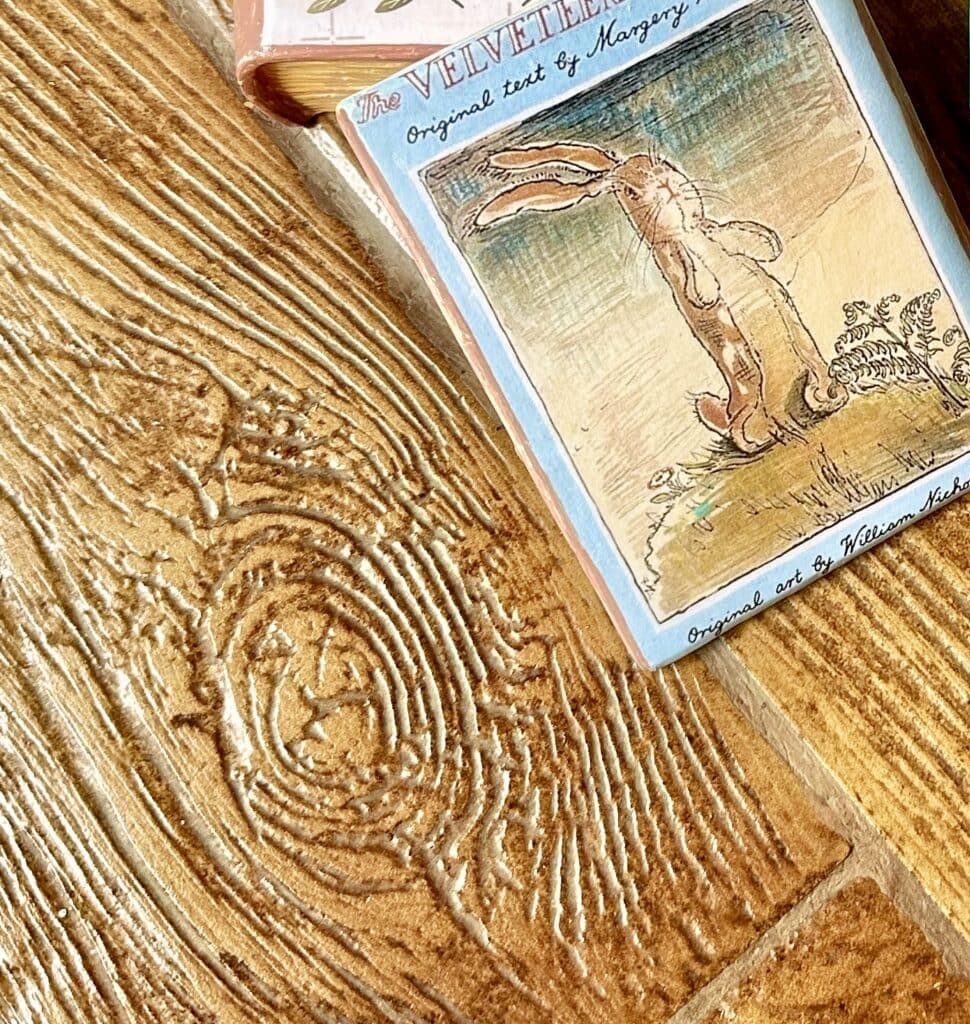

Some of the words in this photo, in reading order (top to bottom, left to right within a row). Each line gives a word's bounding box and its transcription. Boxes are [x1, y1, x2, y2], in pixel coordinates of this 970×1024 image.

[354, 88, 402, 125] The
[405, 88, 495, 145] Original
[501, 65, 547, 99] text
[554, 52, 581, 77] by
[585, 0, 690, 59] Margery
[687, 592, 765, 644] Original
[775, 570, 804, 594] art
[811, 555, 835, 574] by
[839, 511, 917, 556] William
